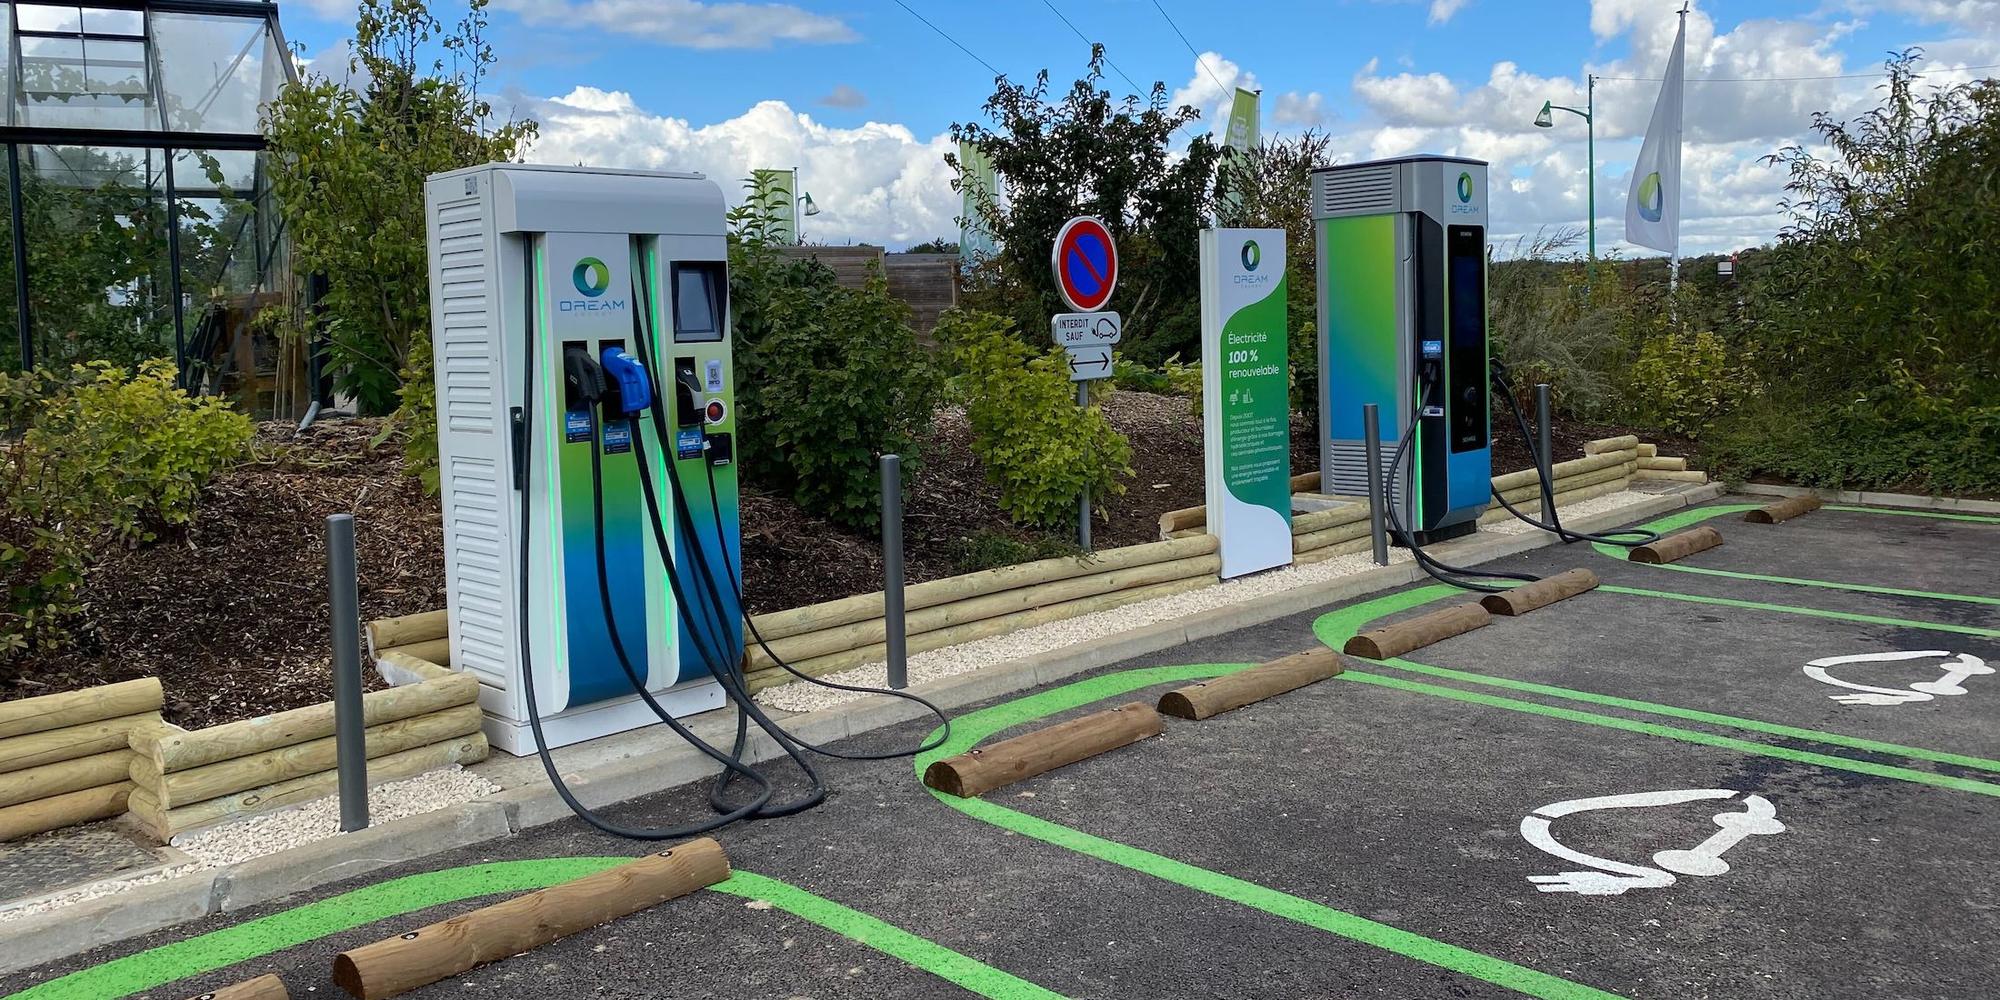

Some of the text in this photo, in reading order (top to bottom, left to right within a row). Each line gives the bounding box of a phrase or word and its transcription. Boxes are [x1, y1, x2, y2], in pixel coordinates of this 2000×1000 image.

[1233, 274, 1268, 284] DREAM
[560, 300, 625, 311] DREAM
[1060, 319, 1089, 329] INTERDIT
[1066, 331, 1083, 341] SAUF
[1228, 331, 1267, 345] Électricité
[1228, 349, 1259, 364] 100 %
[1229, 364, 1280, 379] renouvelable
